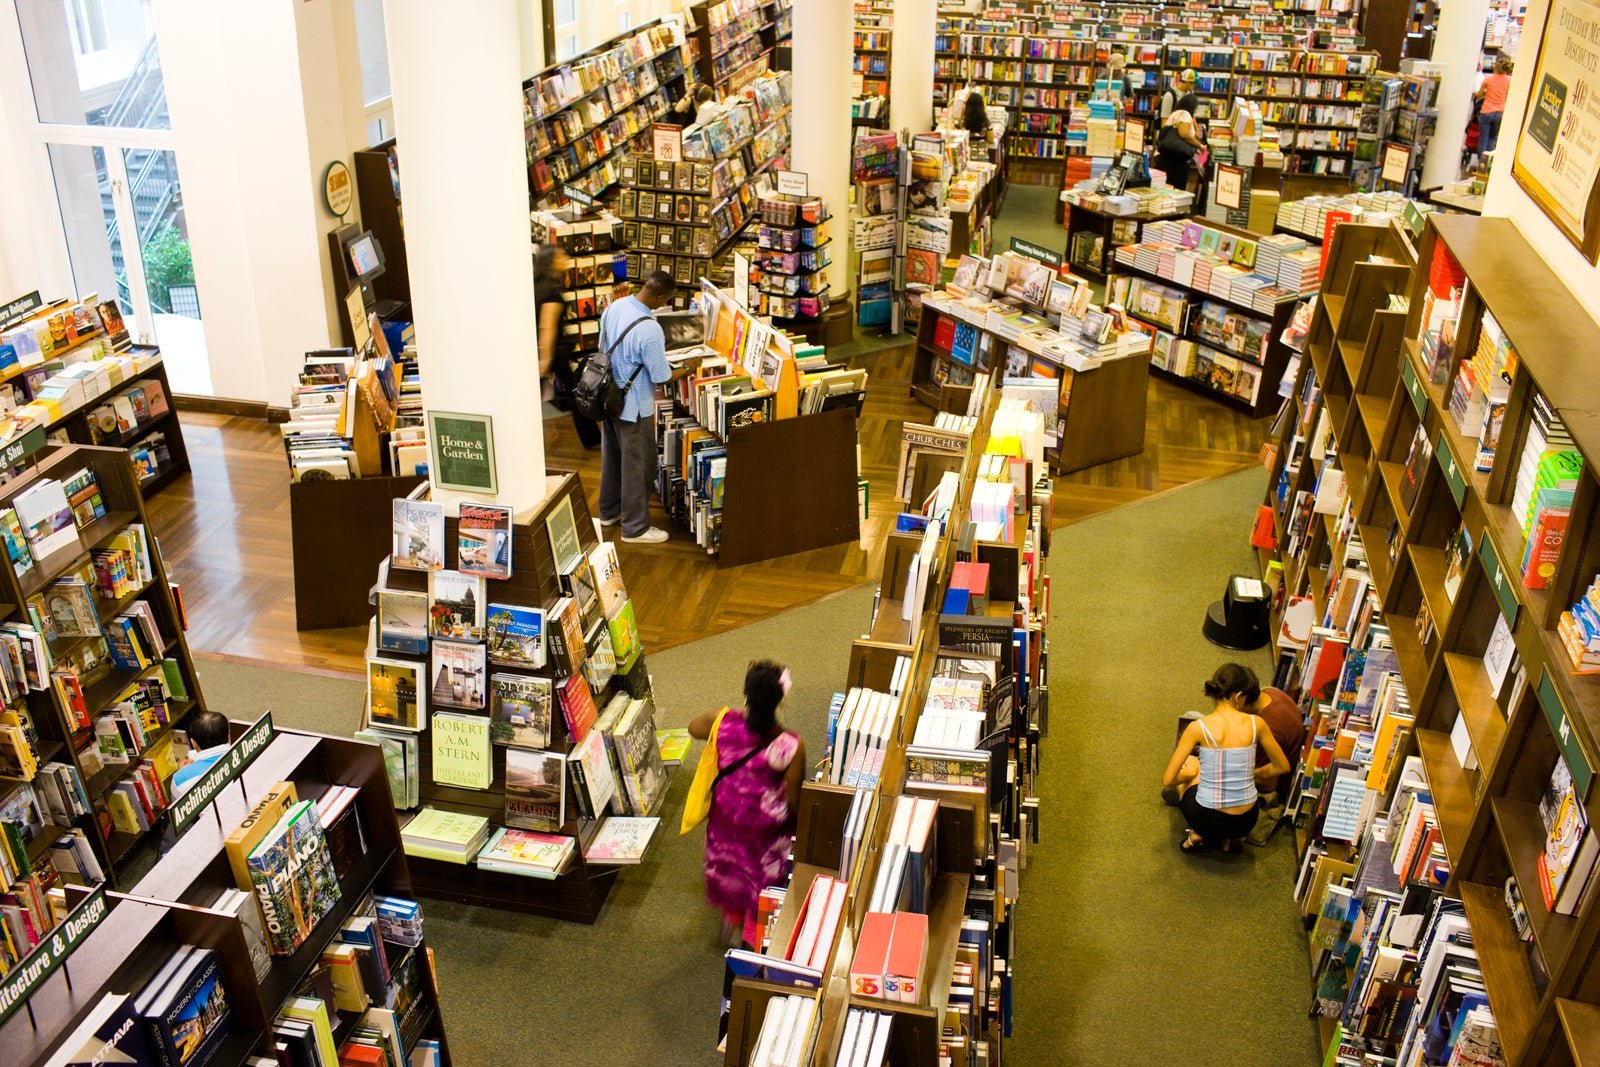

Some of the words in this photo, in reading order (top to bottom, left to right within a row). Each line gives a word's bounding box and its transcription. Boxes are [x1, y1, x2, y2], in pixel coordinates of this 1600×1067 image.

[440, 434, 474, 450] Home
[474, 440, 484, 450] &
[905, 432, 963, 450] CHURCHES
[6, 441, 25, 462] Shui
[442, 446, 484, 461] Garden
[459, 518, 496, 529] DESIGN
[945, 626, 976, 635] SPLENDORS
[962, 632, 990, 642] PERSIA
[501, 682, 535, 693] STYLE
[433, 720, 485, 735] ROBERT
[446, 734, 472, 747] A.M.
[438, 746, 481, 762] STERN
[173, 763, 230, 827] Architecture
[231, 748, 241, 769] &
[241, 723, 270, 759] Design
[240, 793, 280, 829] PIANO
[271, 835, 319, 893] PIANO
[255, 883, 282, 935] PIANO
[52, 934, 66, 957] &
[64, 896, 105, 944] Design
